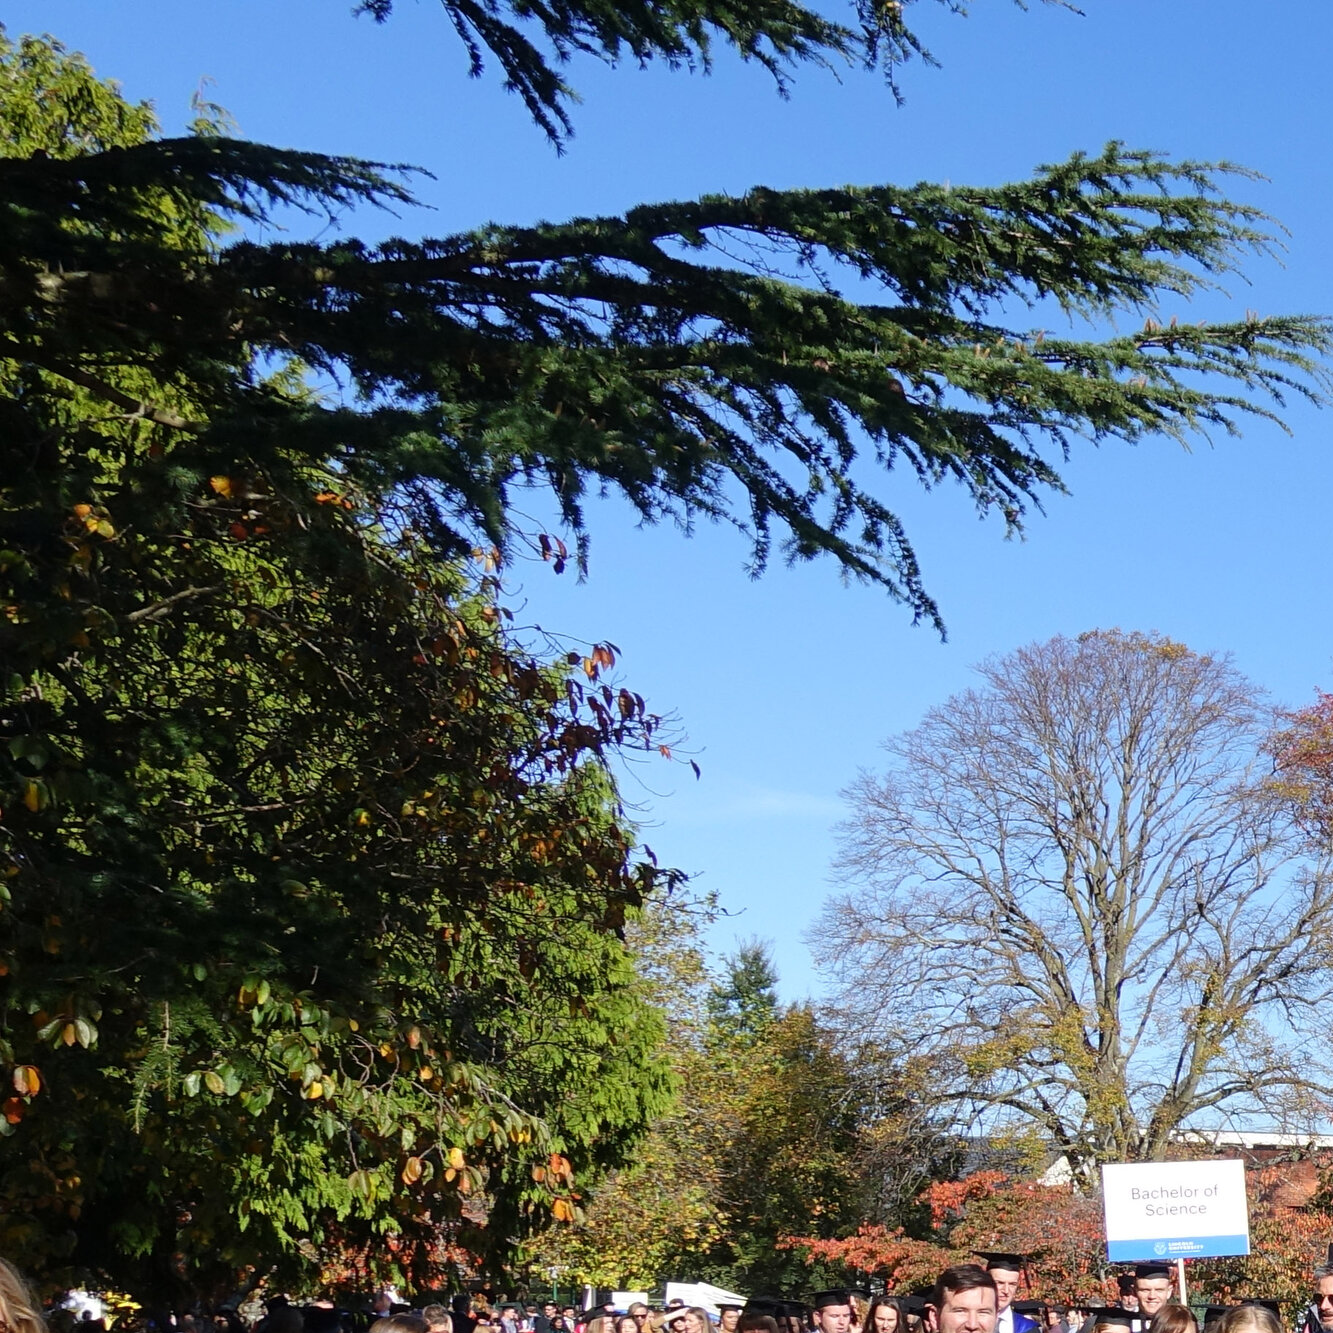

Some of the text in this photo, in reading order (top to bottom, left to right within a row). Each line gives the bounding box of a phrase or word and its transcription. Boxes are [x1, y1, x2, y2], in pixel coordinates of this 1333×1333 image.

[1131, 1184, 1218, 1200] Bachelor of
[1145, 1203, 1207, 1217] Science
